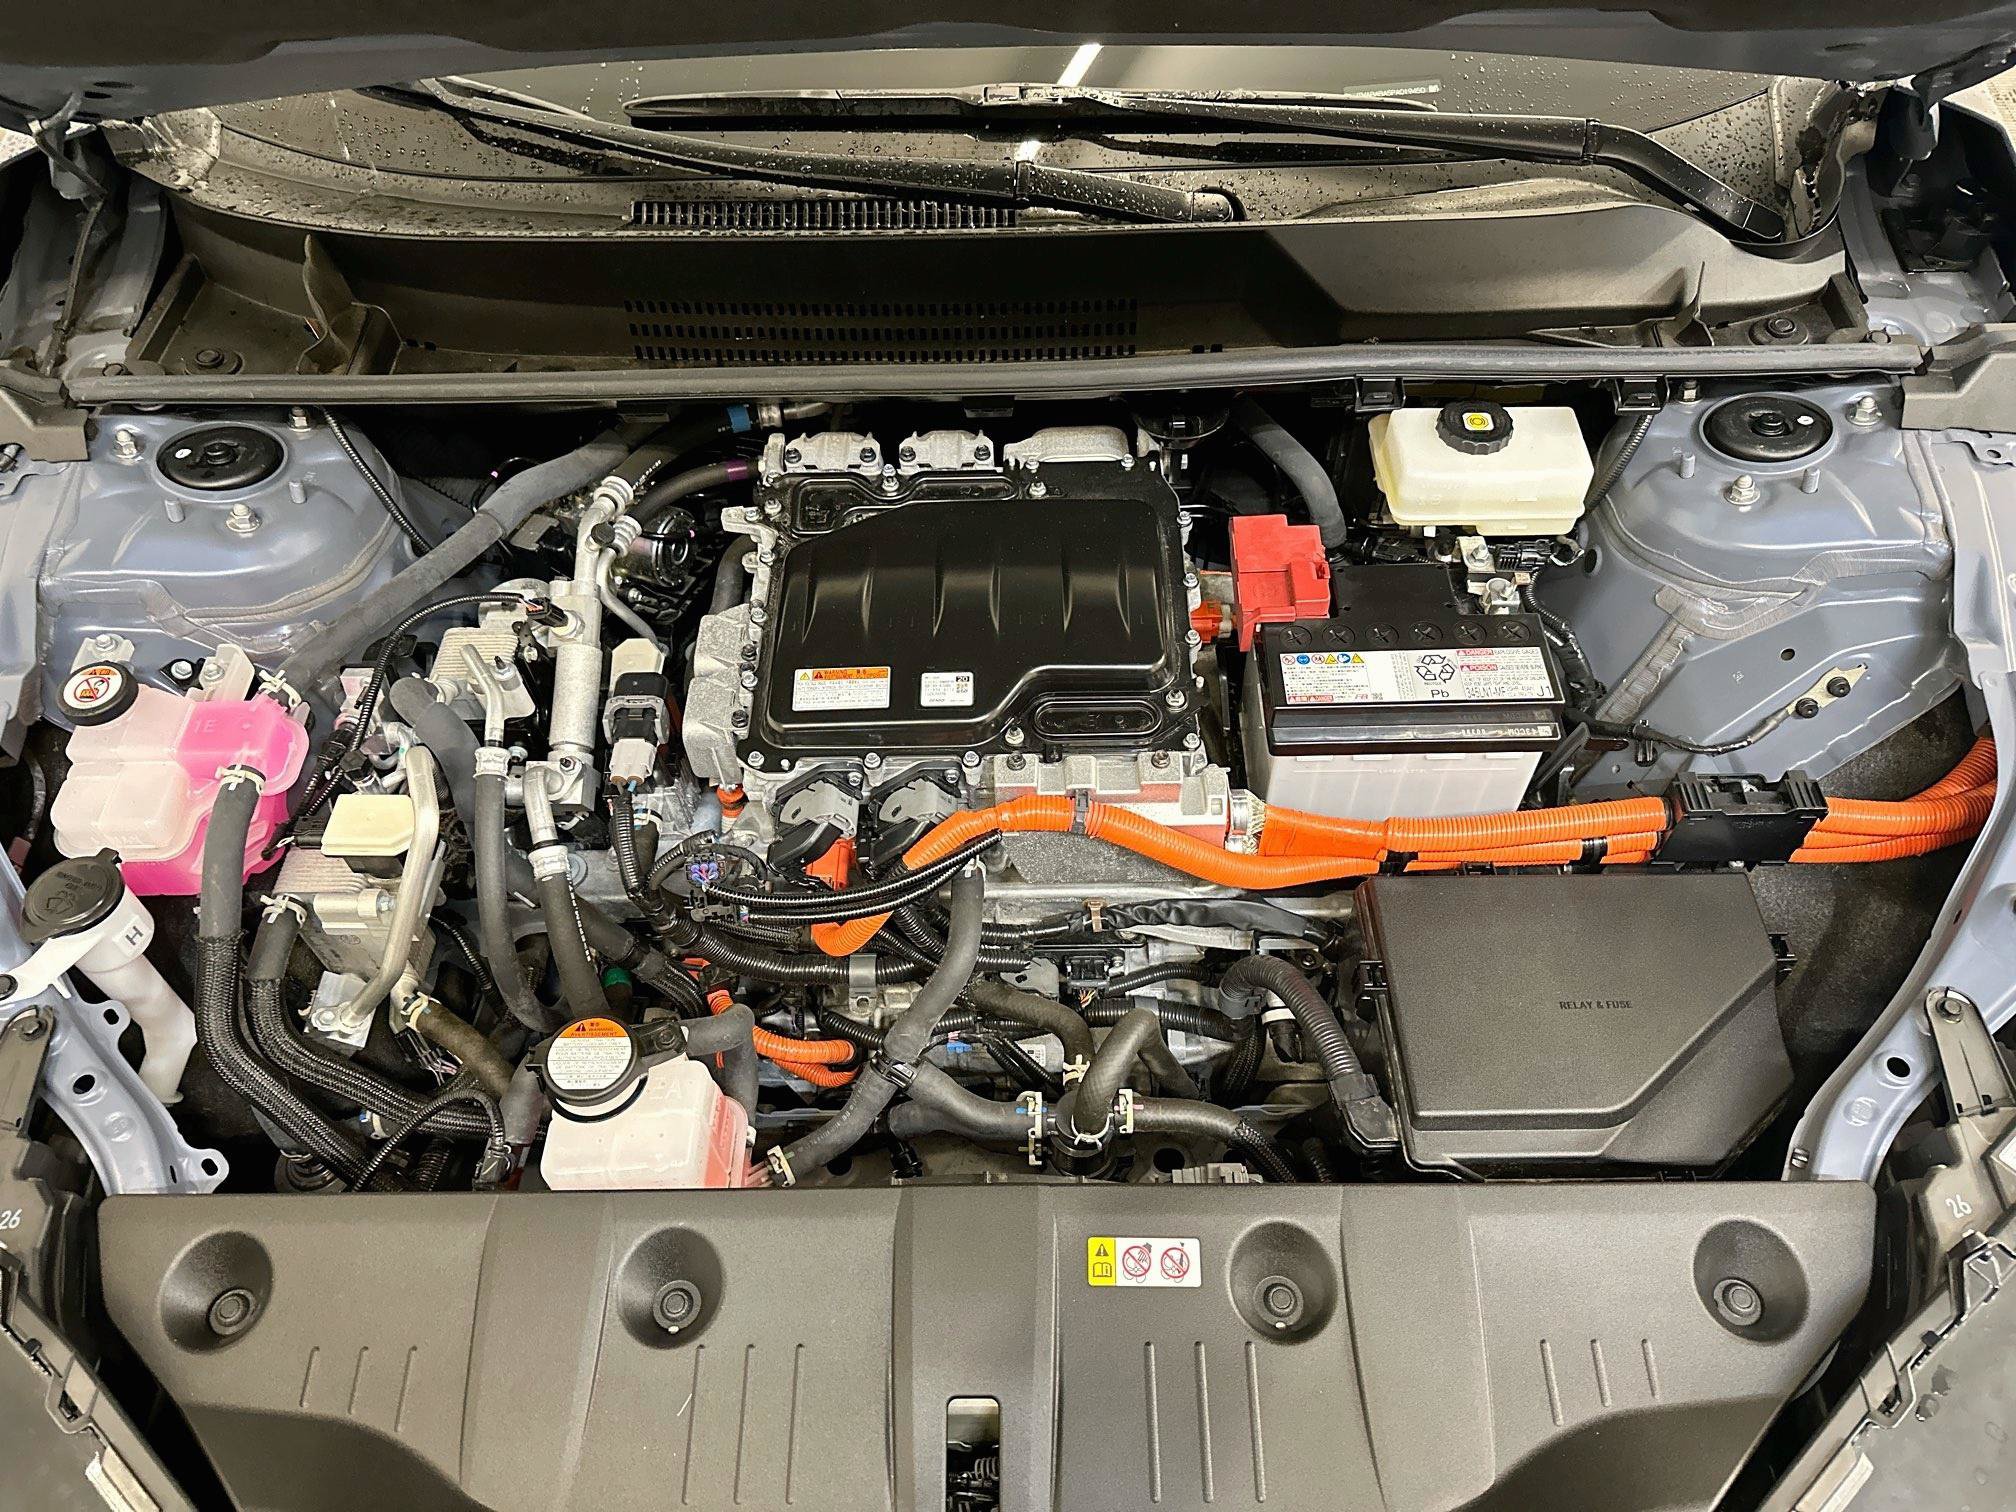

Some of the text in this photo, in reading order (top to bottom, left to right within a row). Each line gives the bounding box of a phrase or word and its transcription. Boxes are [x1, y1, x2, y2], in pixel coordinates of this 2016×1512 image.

[1430, 689, 1450, 699] Pb
[125, 925, 144, 946] H
[1559, 1000, 1633, 1010] RELAY & FUSE
[1945, 1194, 1972, 1219] 26
[0, 1208, 23, 1230] 26
